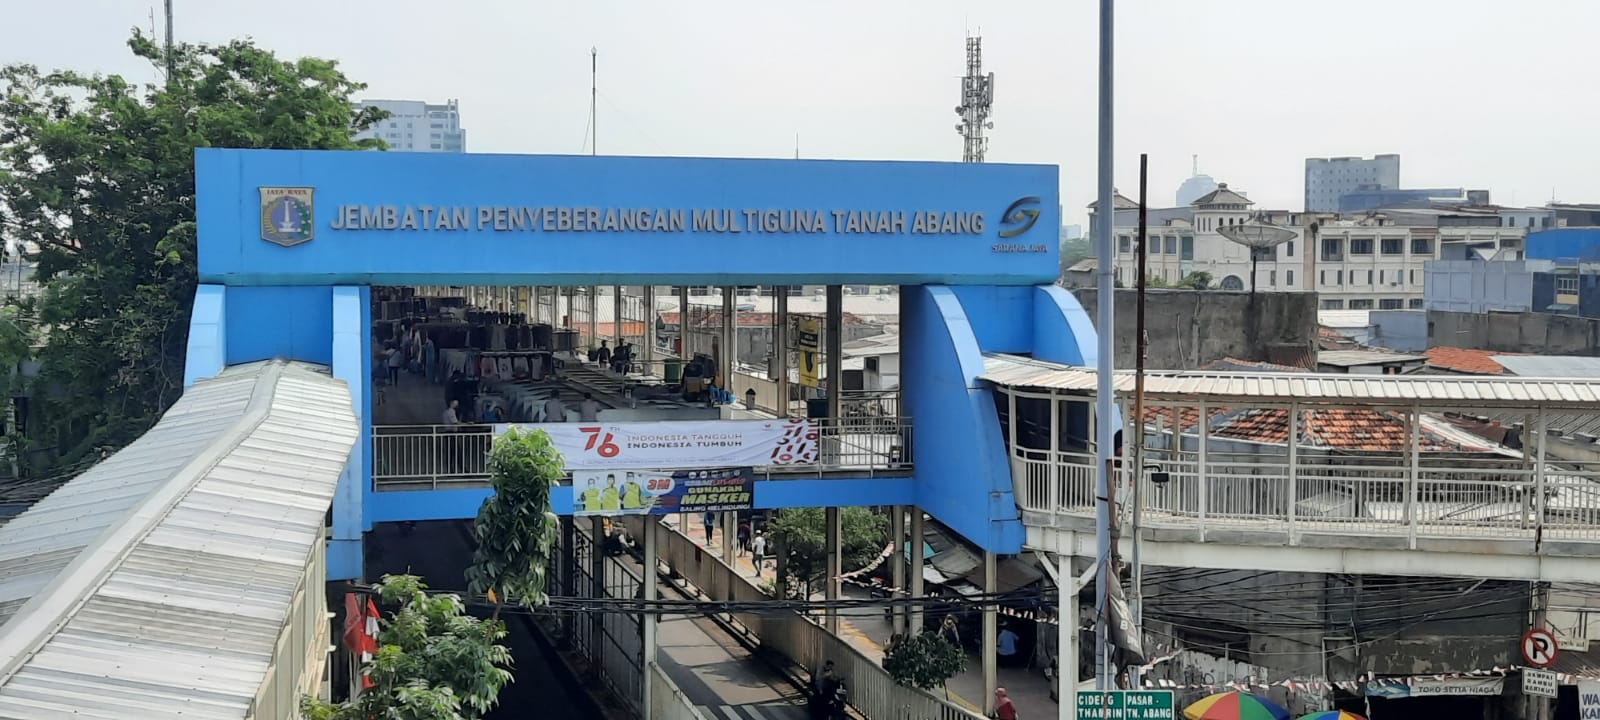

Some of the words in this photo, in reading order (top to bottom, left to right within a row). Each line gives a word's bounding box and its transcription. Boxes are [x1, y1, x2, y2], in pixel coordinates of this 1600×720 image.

[330, 204, 469, 231] JEMBATAN
[477, 206, 685, 233] PENYEBERANGAN
[691, 208, 827, 233] MULTIGUNA
[831, 210, 905, 233] TANAH
[911, 210, 985, 234] ABANG
[578, 427, 620, 457] 76
[627, 441, 692, 449] INDONESIA
[688, 485, 743, 494] GUNAKAN
[680, 492, 751, 505] MASKER
[1127, 695, 1153, 706] PASAR
[1127, 708, 1140, 718] TN.
[1143, 708, 1172, 718] ABANG
